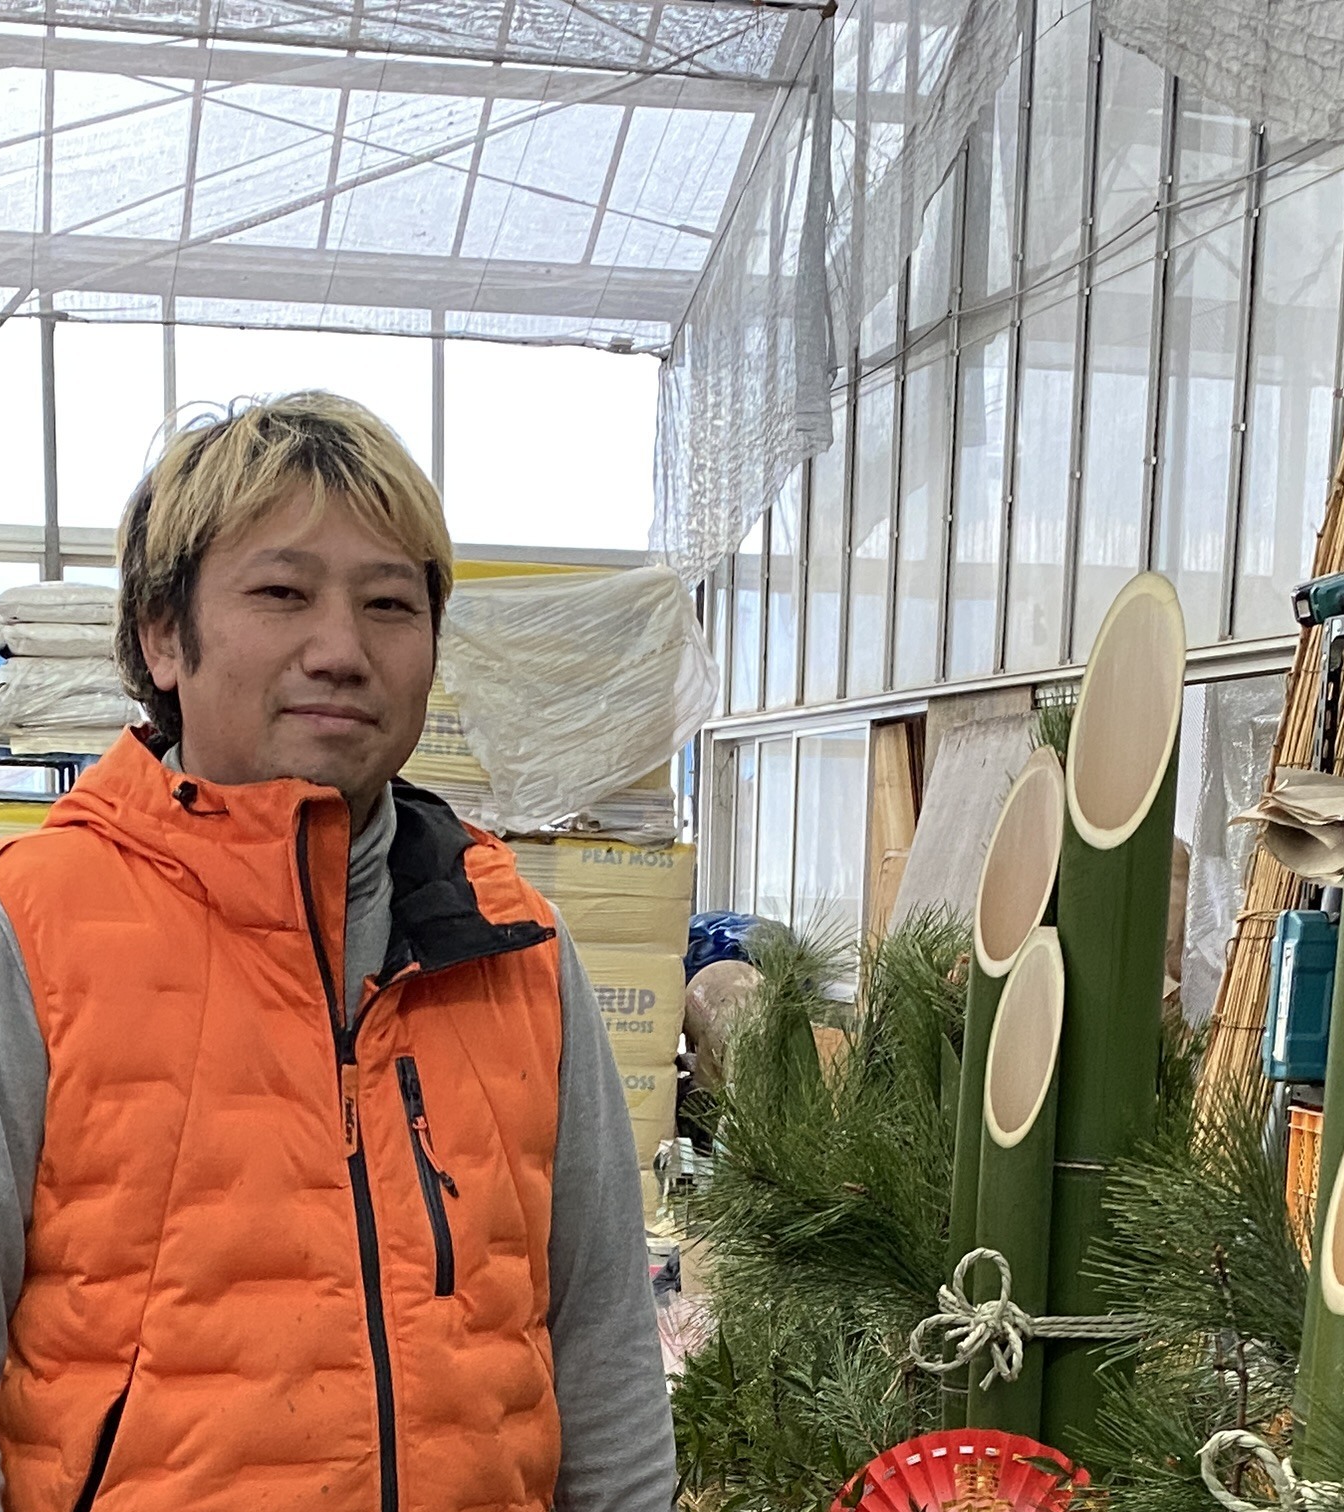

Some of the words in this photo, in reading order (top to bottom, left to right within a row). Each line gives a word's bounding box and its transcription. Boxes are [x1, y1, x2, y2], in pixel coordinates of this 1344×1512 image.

[582, 847, 623, 865] PEAT
[629, 851, 673, 868] MOSS
[594, 987, 655, 1015] RUP
[624, 1075, 655, 1090] OSS
